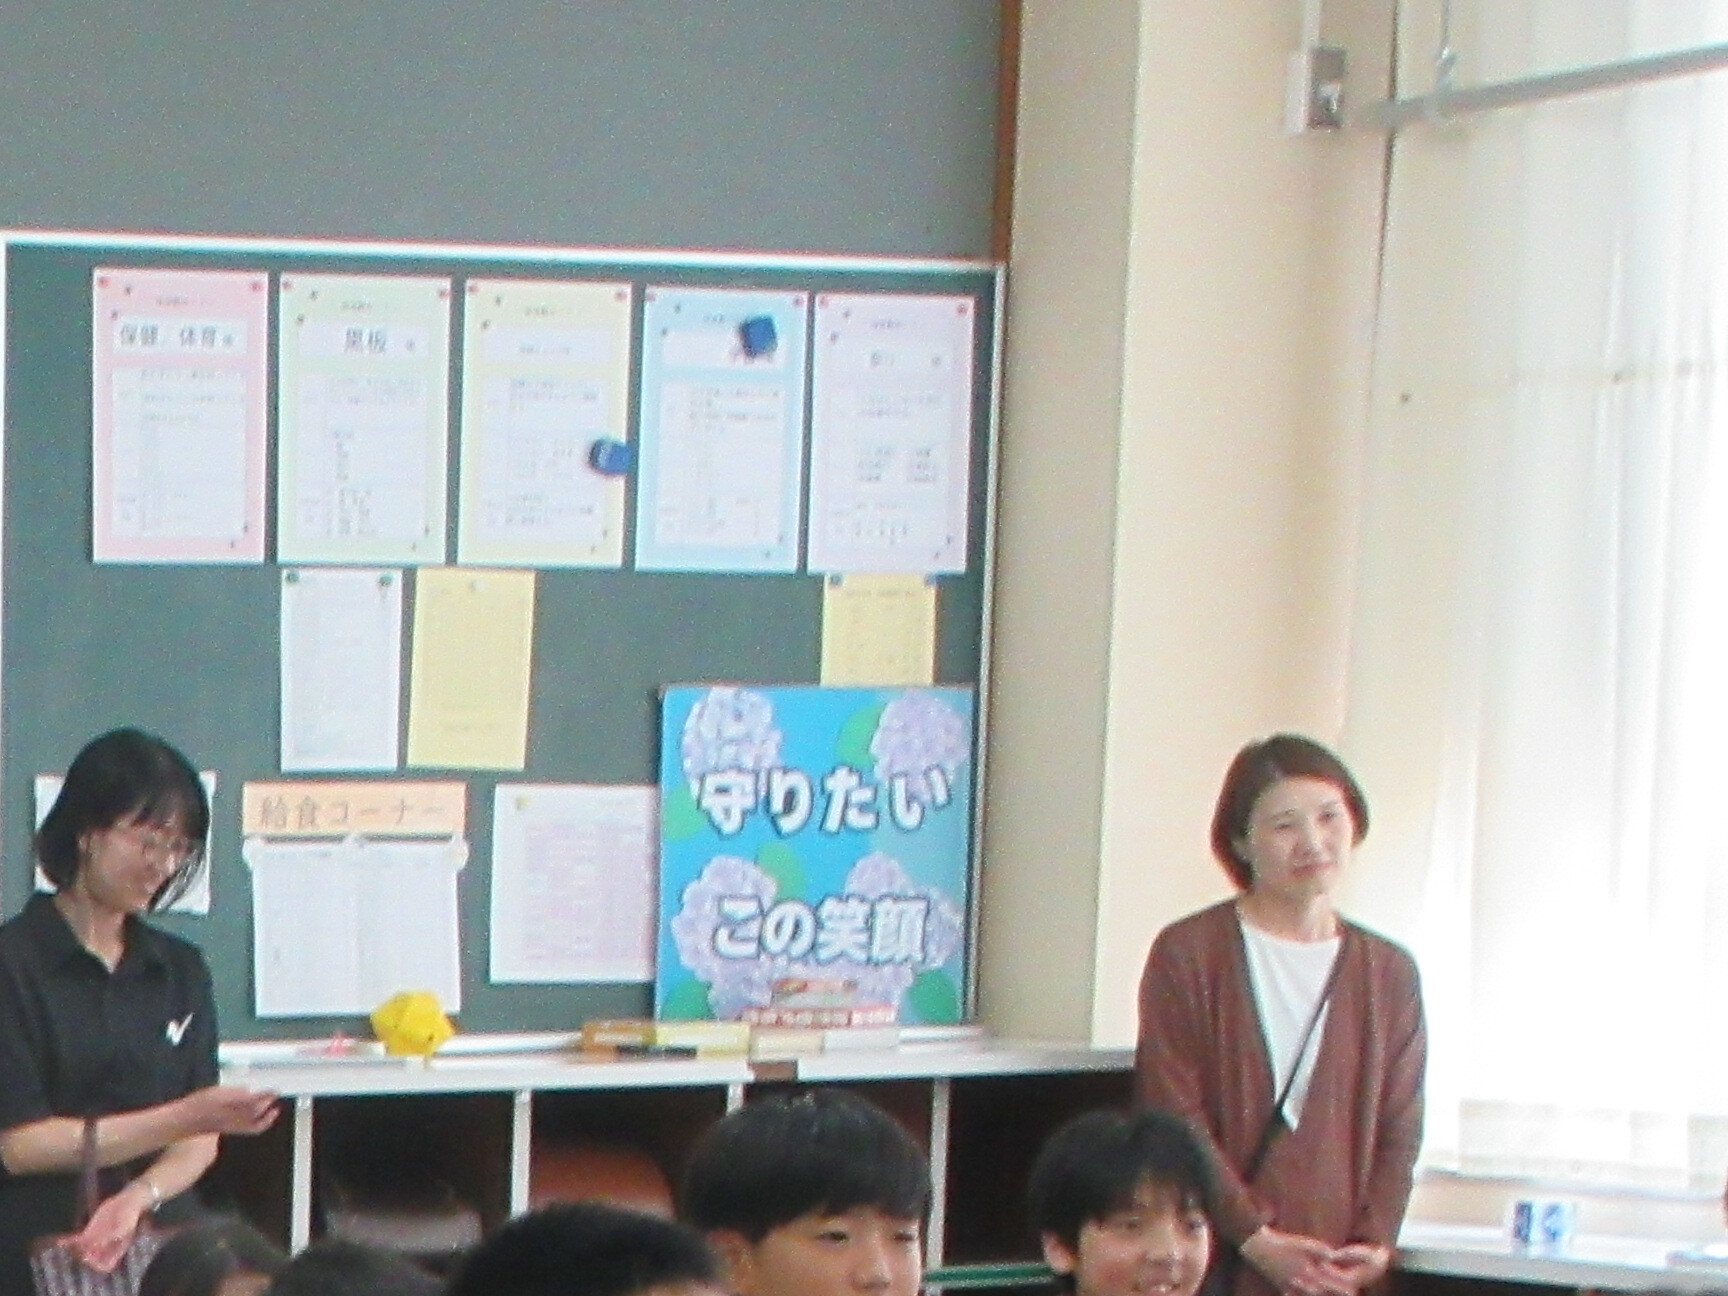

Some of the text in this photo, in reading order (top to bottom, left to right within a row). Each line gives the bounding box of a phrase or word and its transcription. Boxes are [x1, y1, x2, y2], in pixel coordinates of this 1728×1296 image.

[259, 795, 446, 828] 給食コーナー
[697, 764, 953, 836] 守りたい
[713, 894, 932, 965] この笑顔
